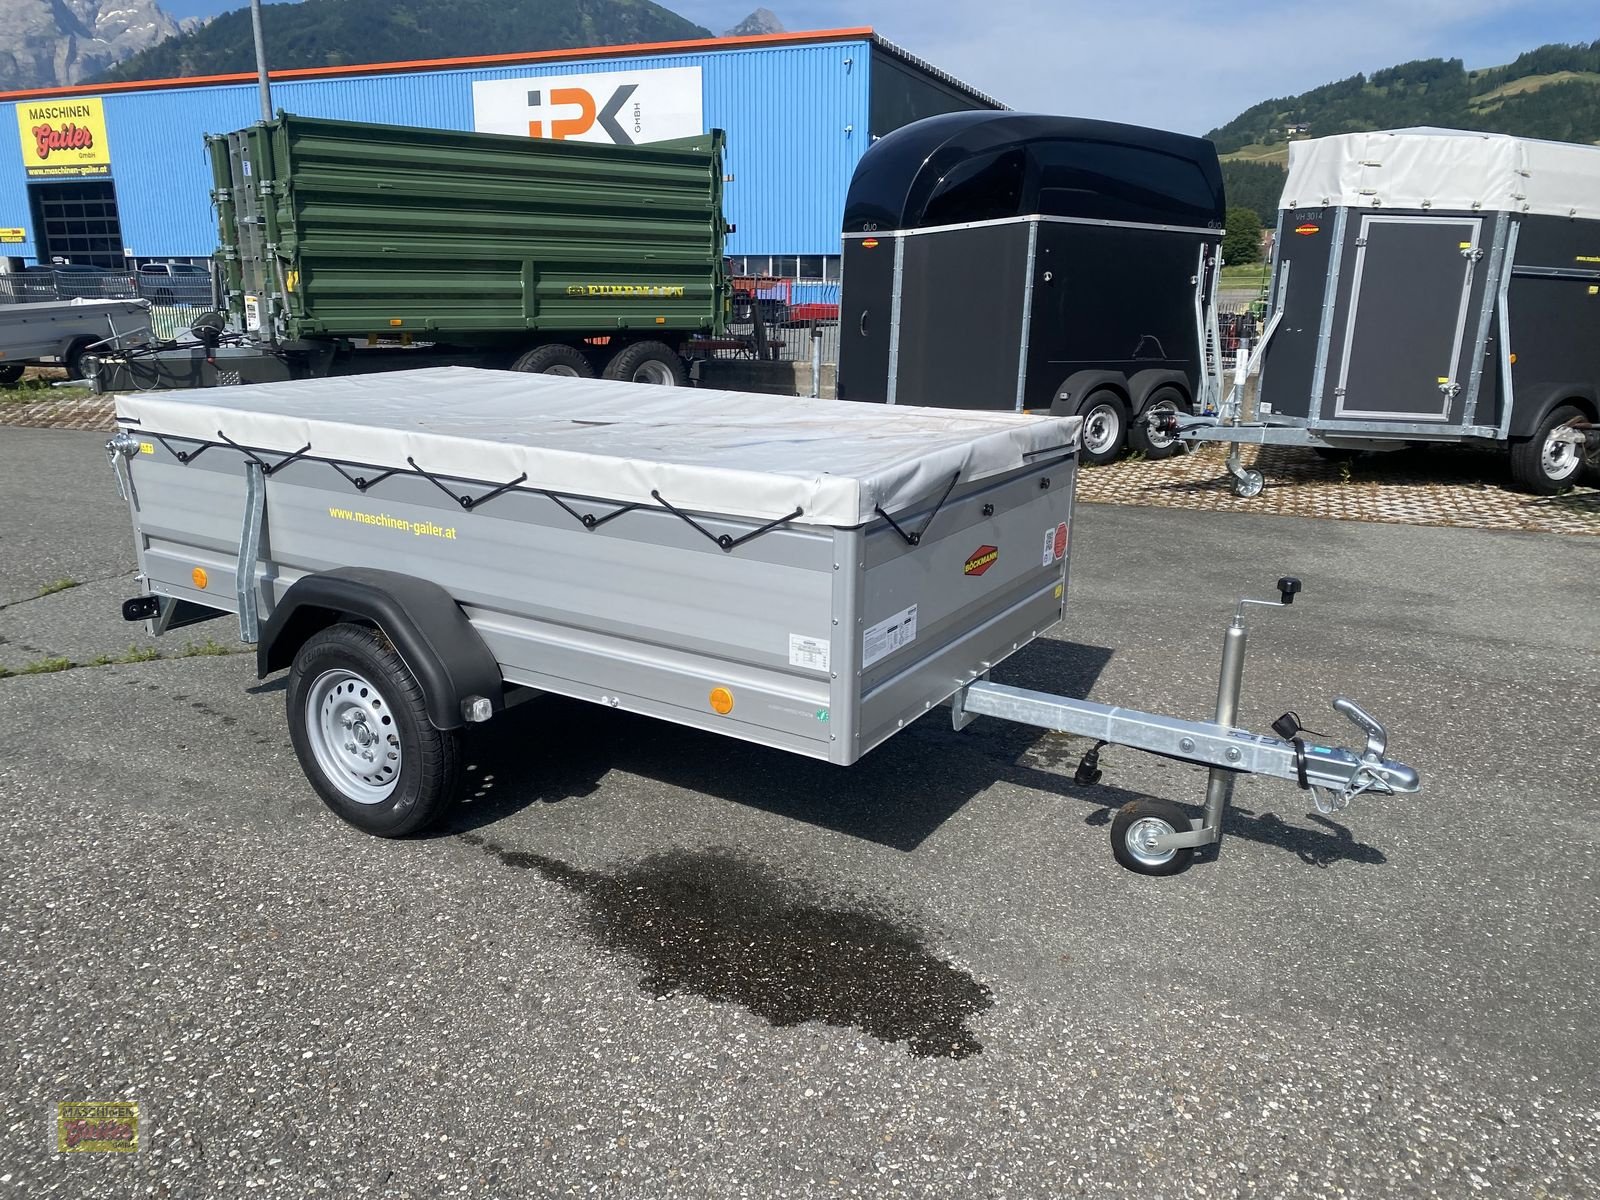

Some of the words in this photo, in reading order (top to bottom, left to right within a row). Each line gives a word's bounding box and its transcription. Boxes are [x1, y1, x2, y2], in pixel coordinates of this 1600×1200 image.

[29, 105, 90, 120] MASCHINEN
[633, 102, 641, 133] GMBH
[32, 123, 93, 159] Gailer
[28, 166, 107, 175] www.maschinen-gailer.at
[1307, 212, 1322, 220] 3014
[863, 221, 877, 231] duo
[587, 285, 684, 296] FUHRMANN
[328, 507, 457, 539] www.maschinen-gailer.at
[965, 551, 998, 572] BÖCKMANN
